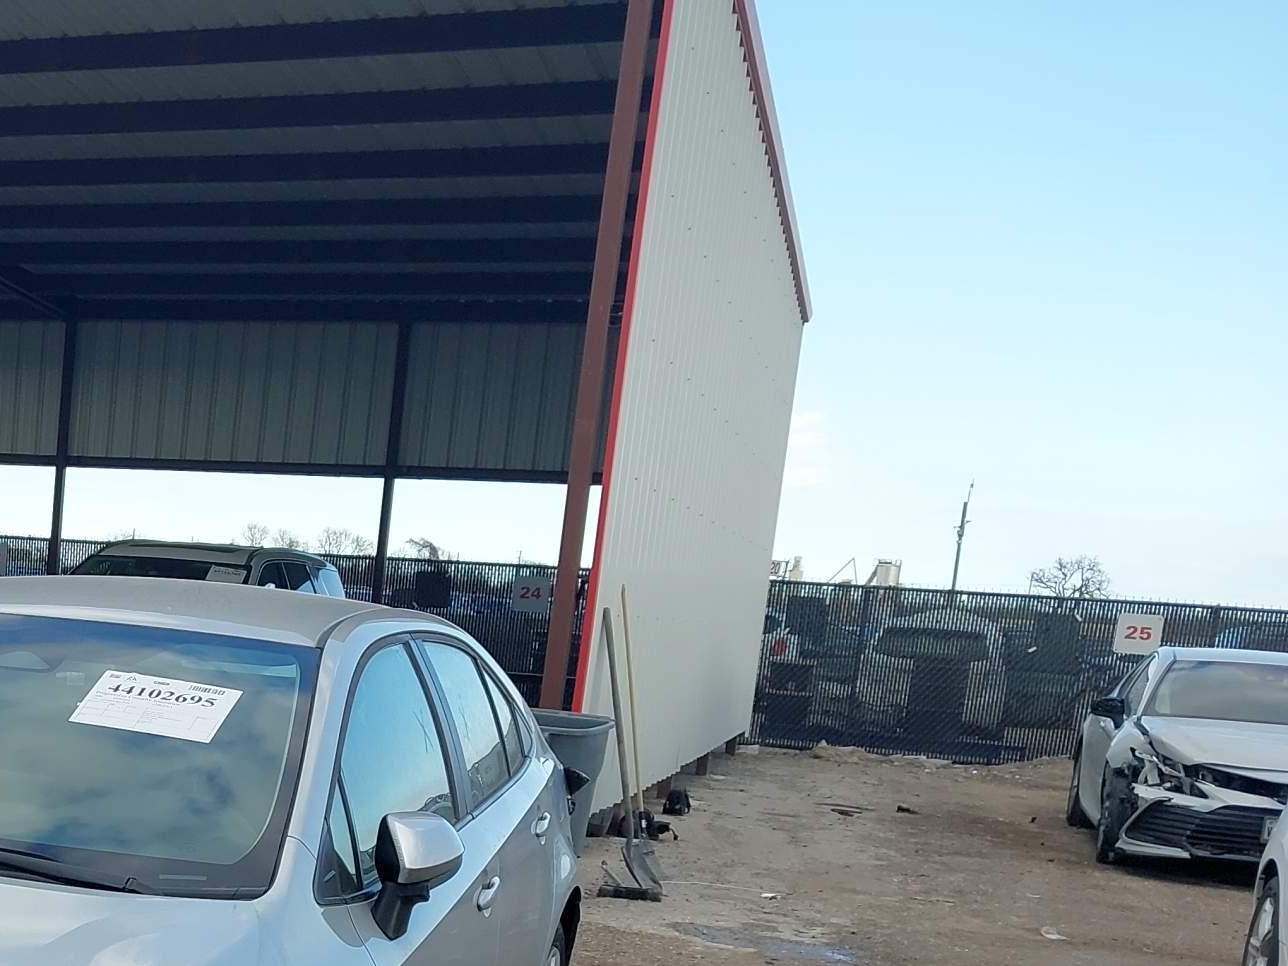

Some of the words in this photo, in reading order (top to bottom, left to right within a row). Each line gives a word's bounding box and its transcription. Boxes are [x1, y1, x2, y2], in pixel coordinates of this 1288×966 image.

[519, 586, 542, 600] 24
[1124, 625, 1153, 641] 25
[108, 683, 217, 708] 44102695
